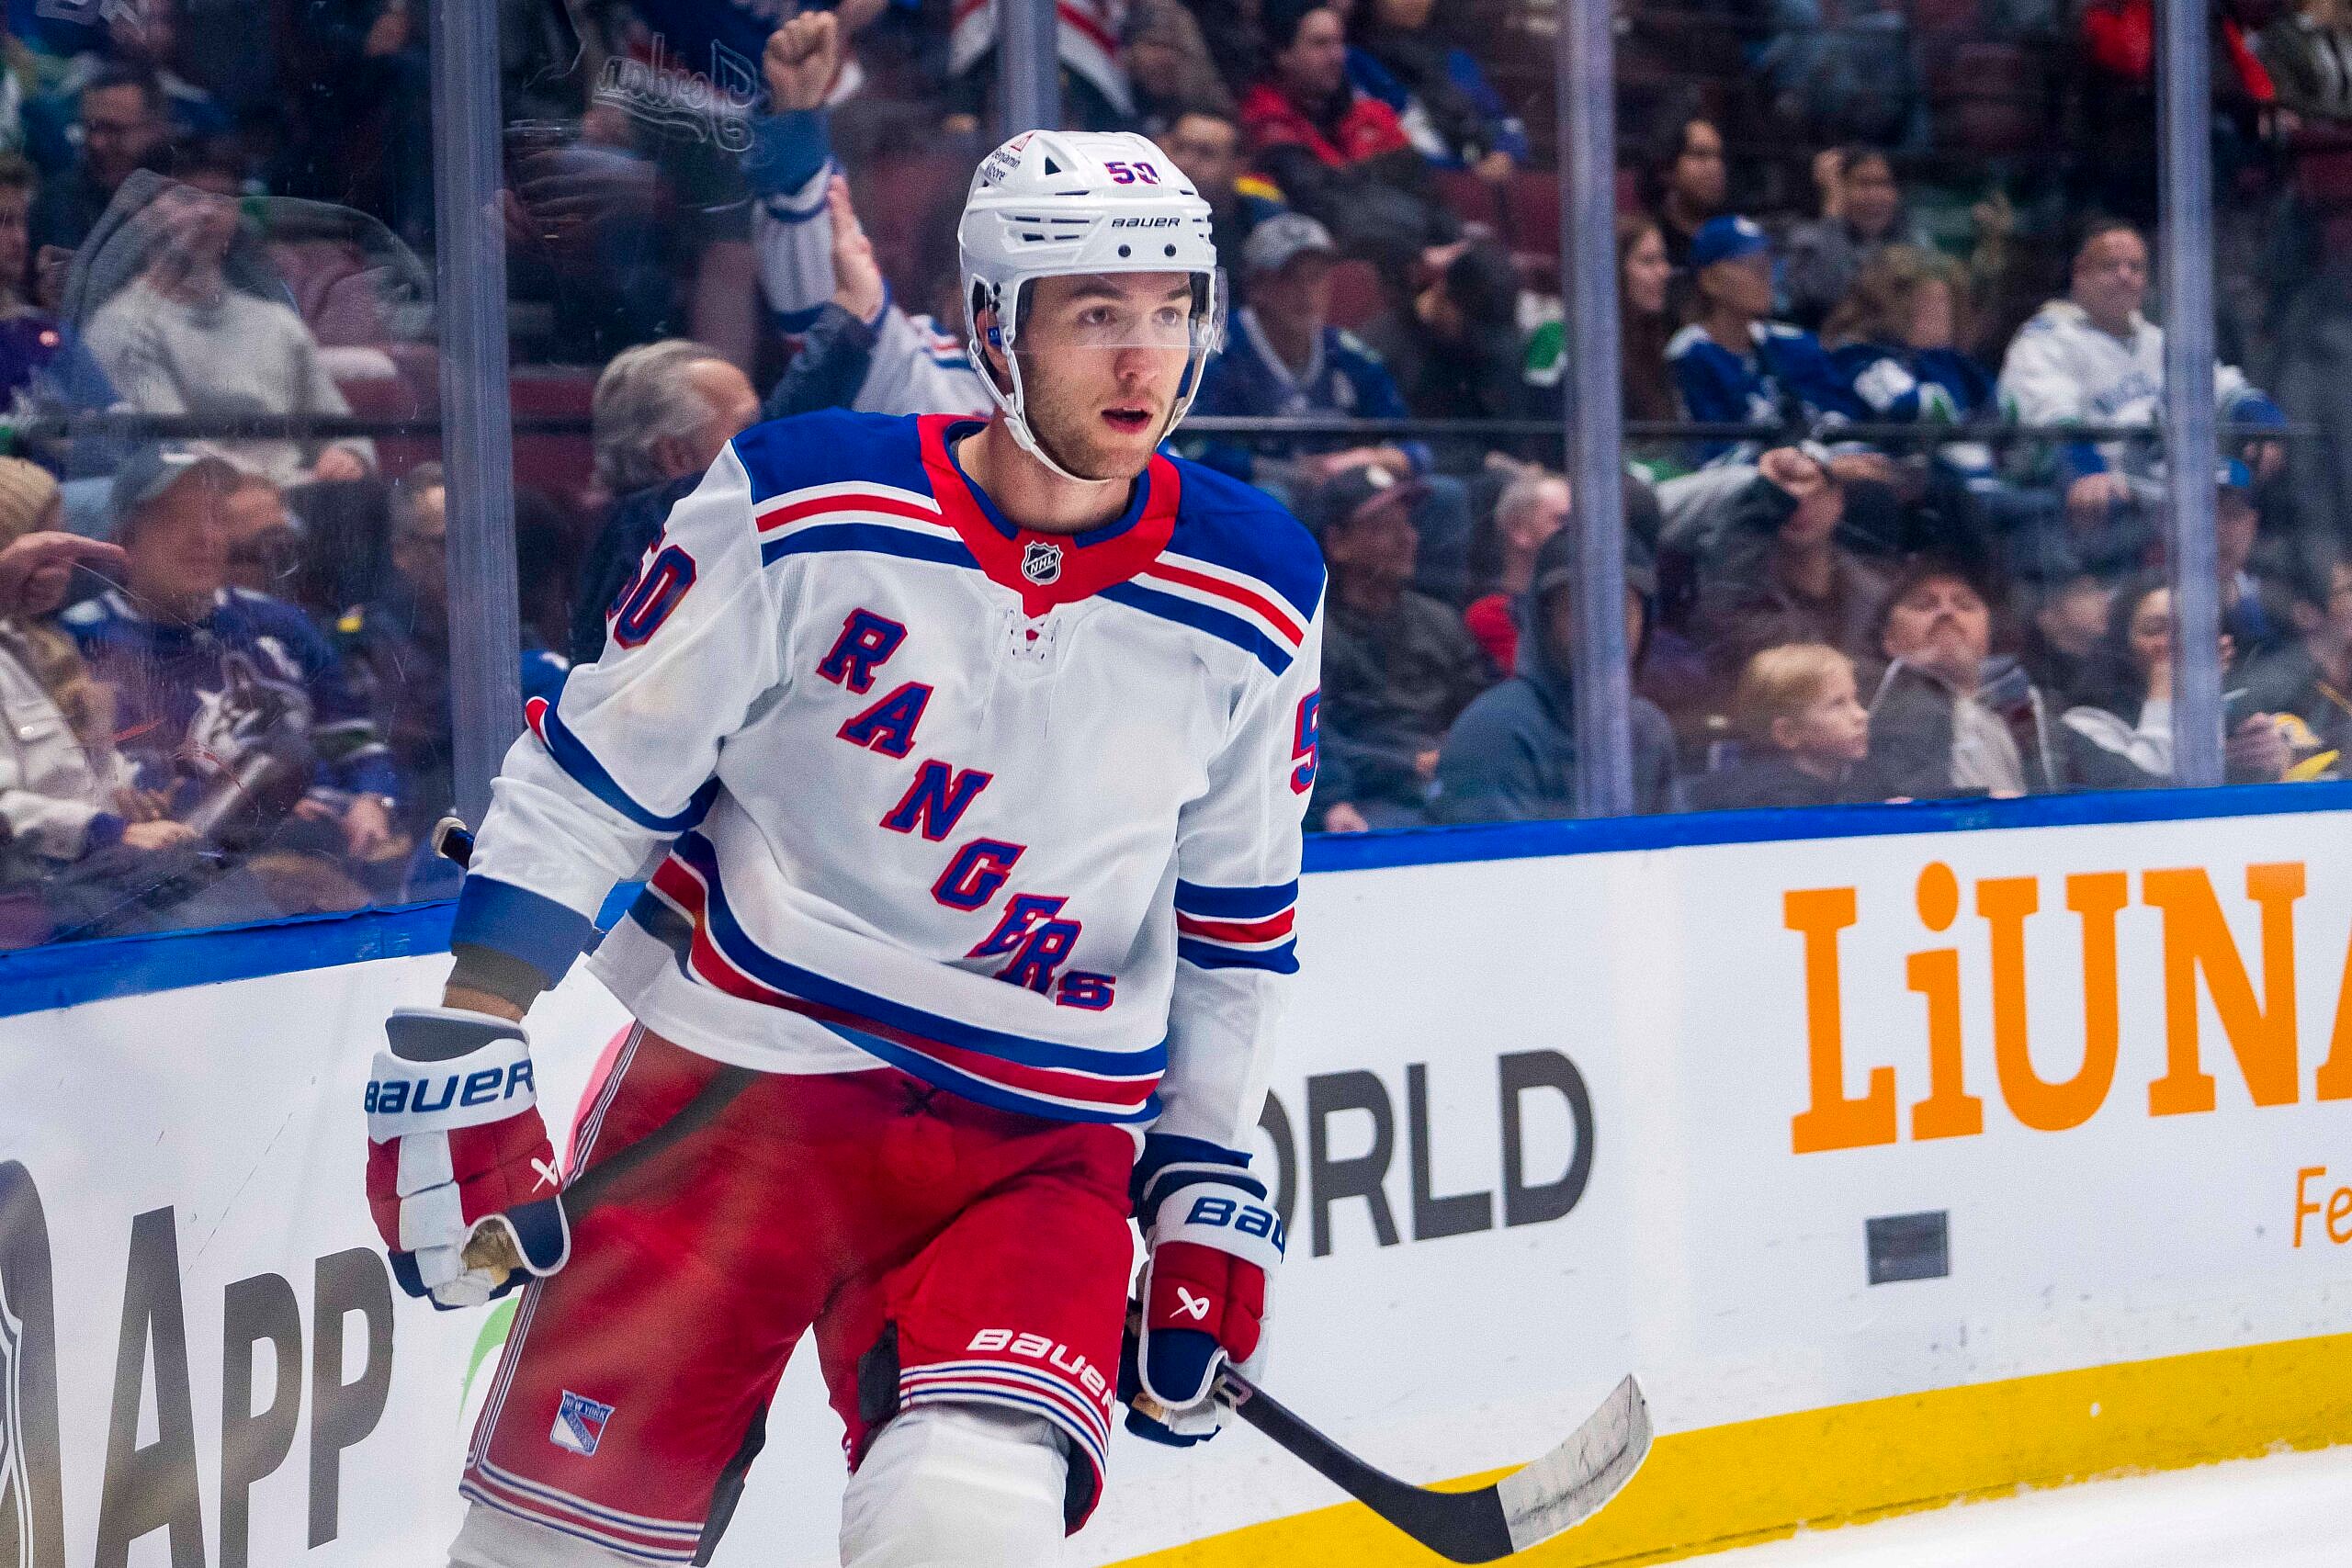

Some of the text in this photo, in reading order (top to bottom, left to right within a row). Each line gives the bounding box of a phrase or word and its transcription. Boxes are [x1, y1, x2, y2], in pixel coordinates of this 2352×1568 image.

[1111, 217, 1181, 228] BAUER
[1030, 555, 1056, 575] NHL
[816, 607, 1116, 1011] RANGERS
[1782, 860, 2352, 1155] LiUN
[364, 1058, 535, 1114] BAUER
[94, 1204, 394, 1568] APP
[584, 1404, 606, 1422] YORK
